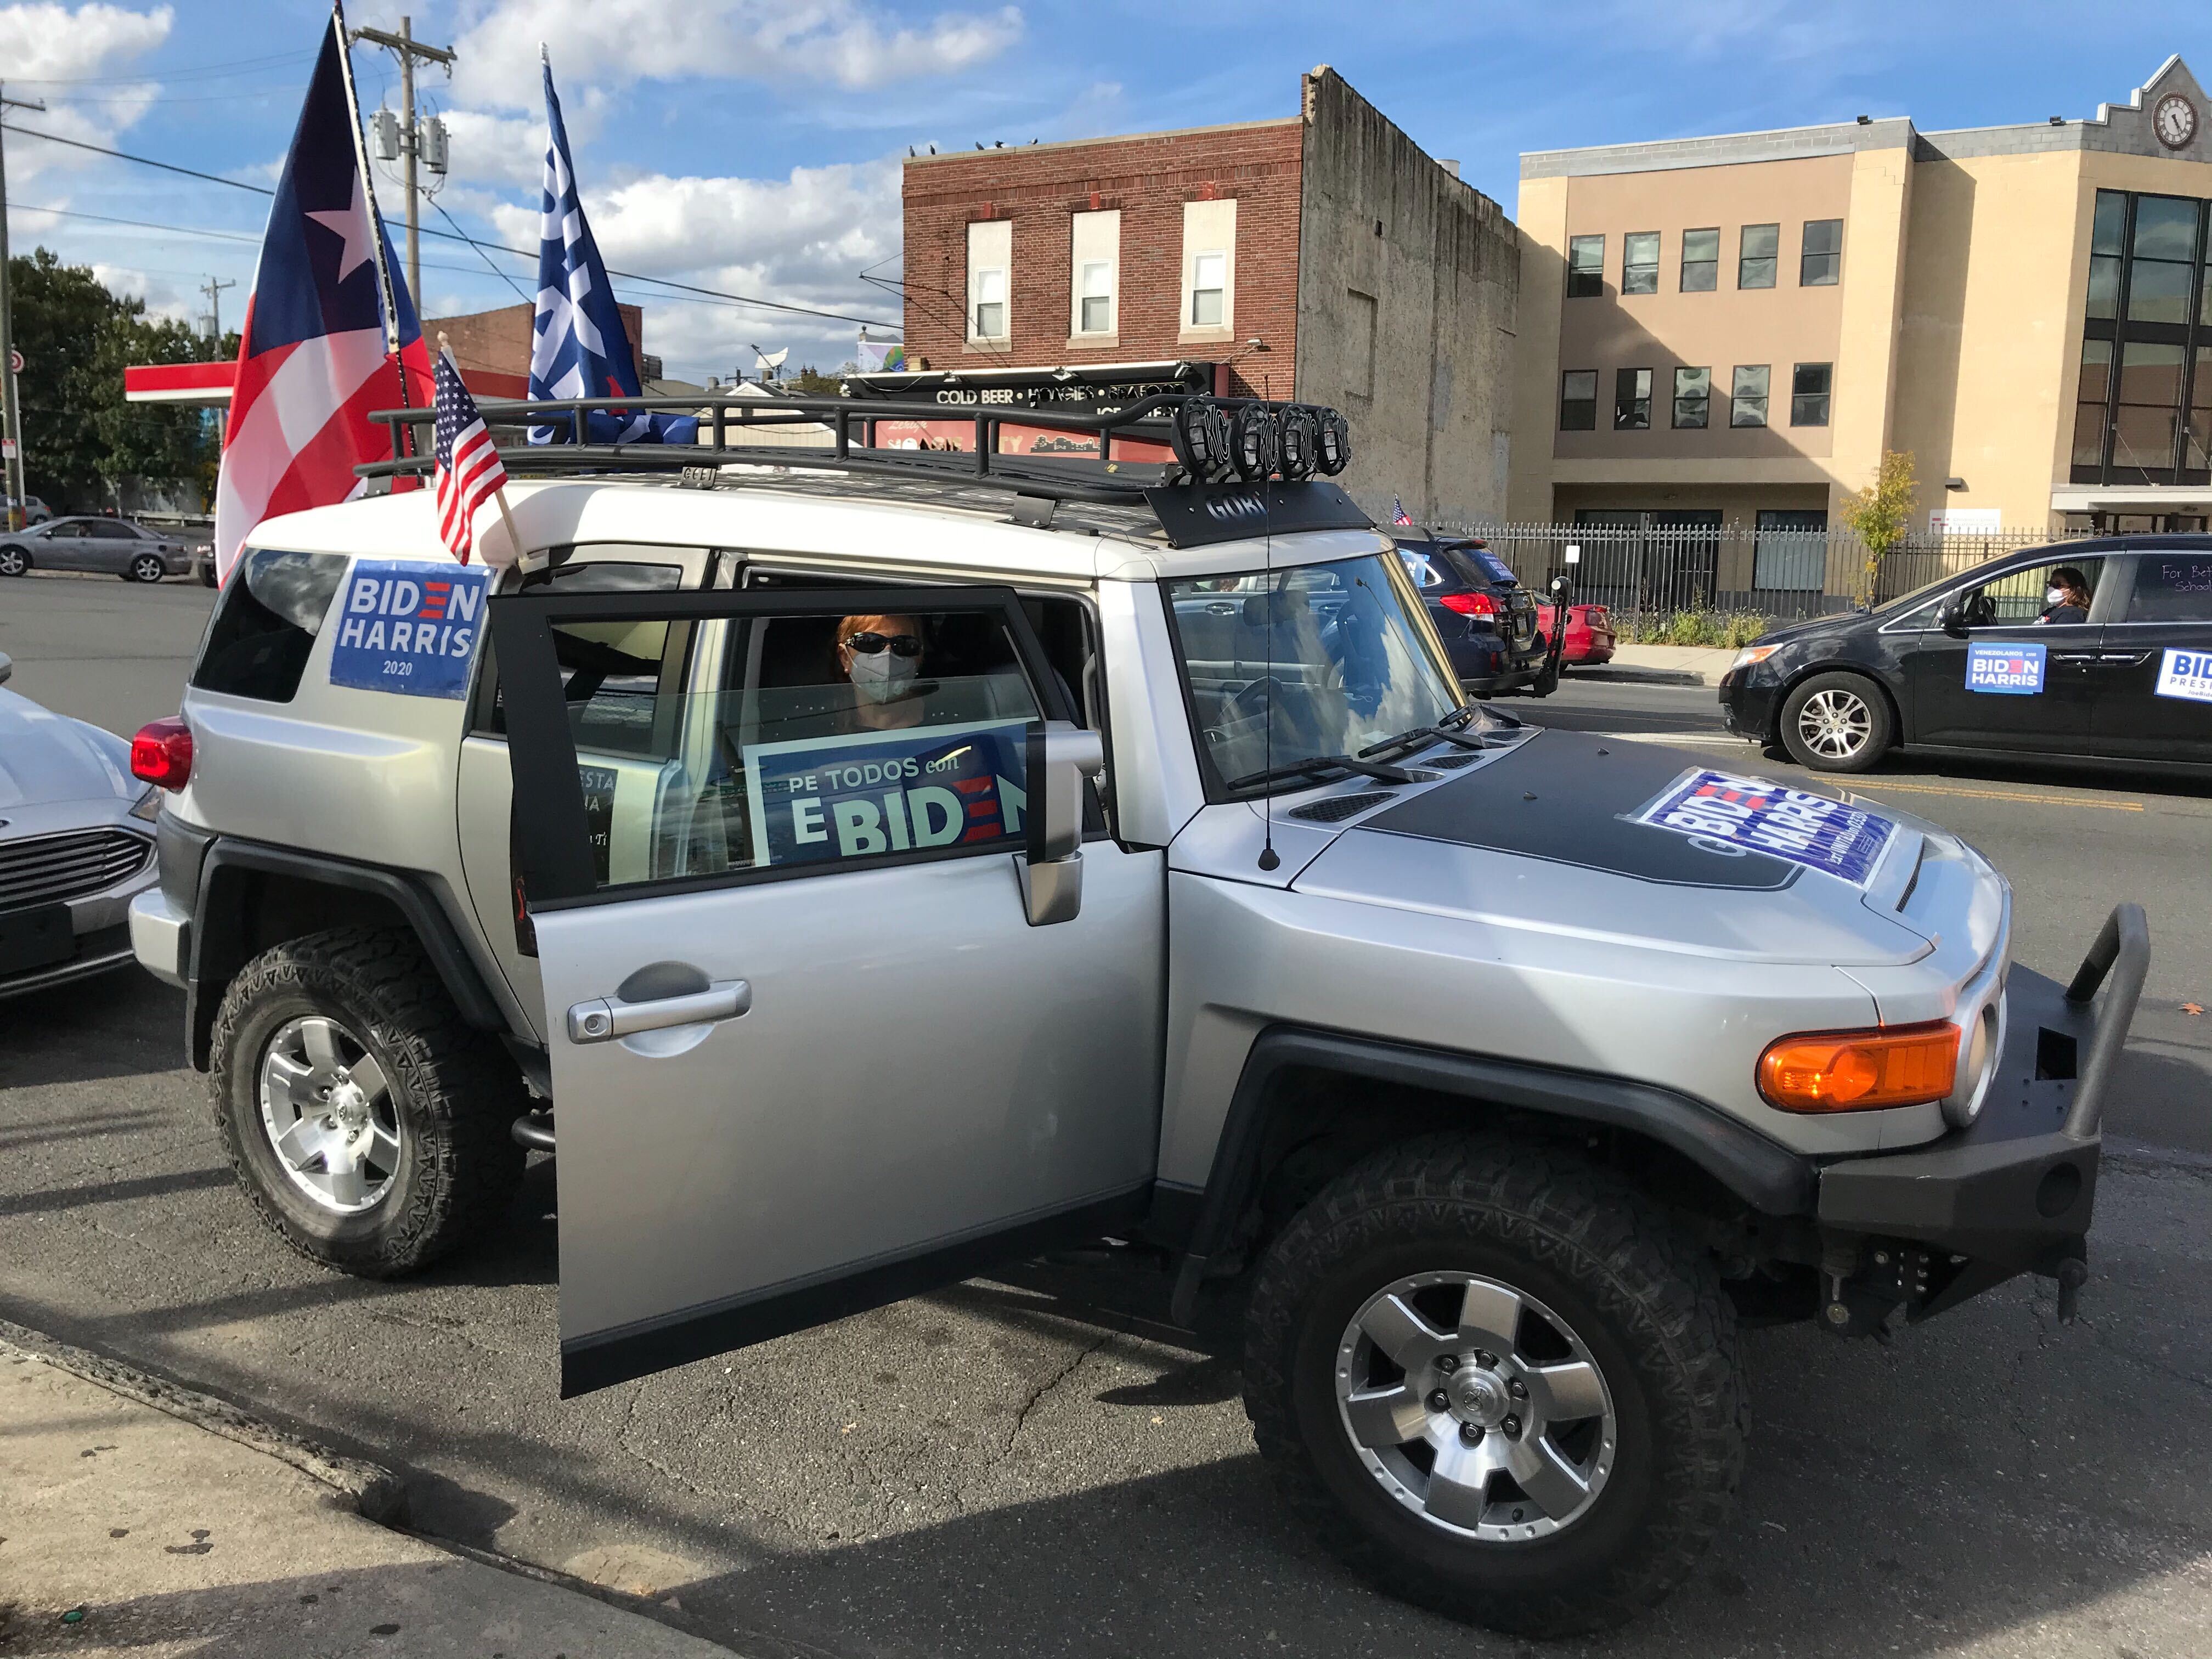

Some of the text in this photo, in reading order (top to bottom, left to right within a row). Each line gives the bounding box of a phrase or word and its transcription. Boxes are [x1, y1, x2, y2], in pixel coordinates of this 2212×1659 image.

[936, 390, 977, 404] COLD
[981, 389, 1014, 404] BEER
[1204, 404, 1230, 464] KC
[1261, 413, 1279, 471] KC
[1301, 413, 1318, 468] KC
[2162, 565, 2212, 579] For Bet
[349, 578, 480, 622] BIDEN
[340, 618, 472, 658] HARRIS
[382, 660, 413, 676] 2020
[1972, 673, 2038, 686] HARRIS
[1973, 658, 2039, 674] BIDEN
[825, 757, 919, 790] TODOS
[925, 755, 960, 774] con
[1663, 774, 1776, 836] BIDEN
